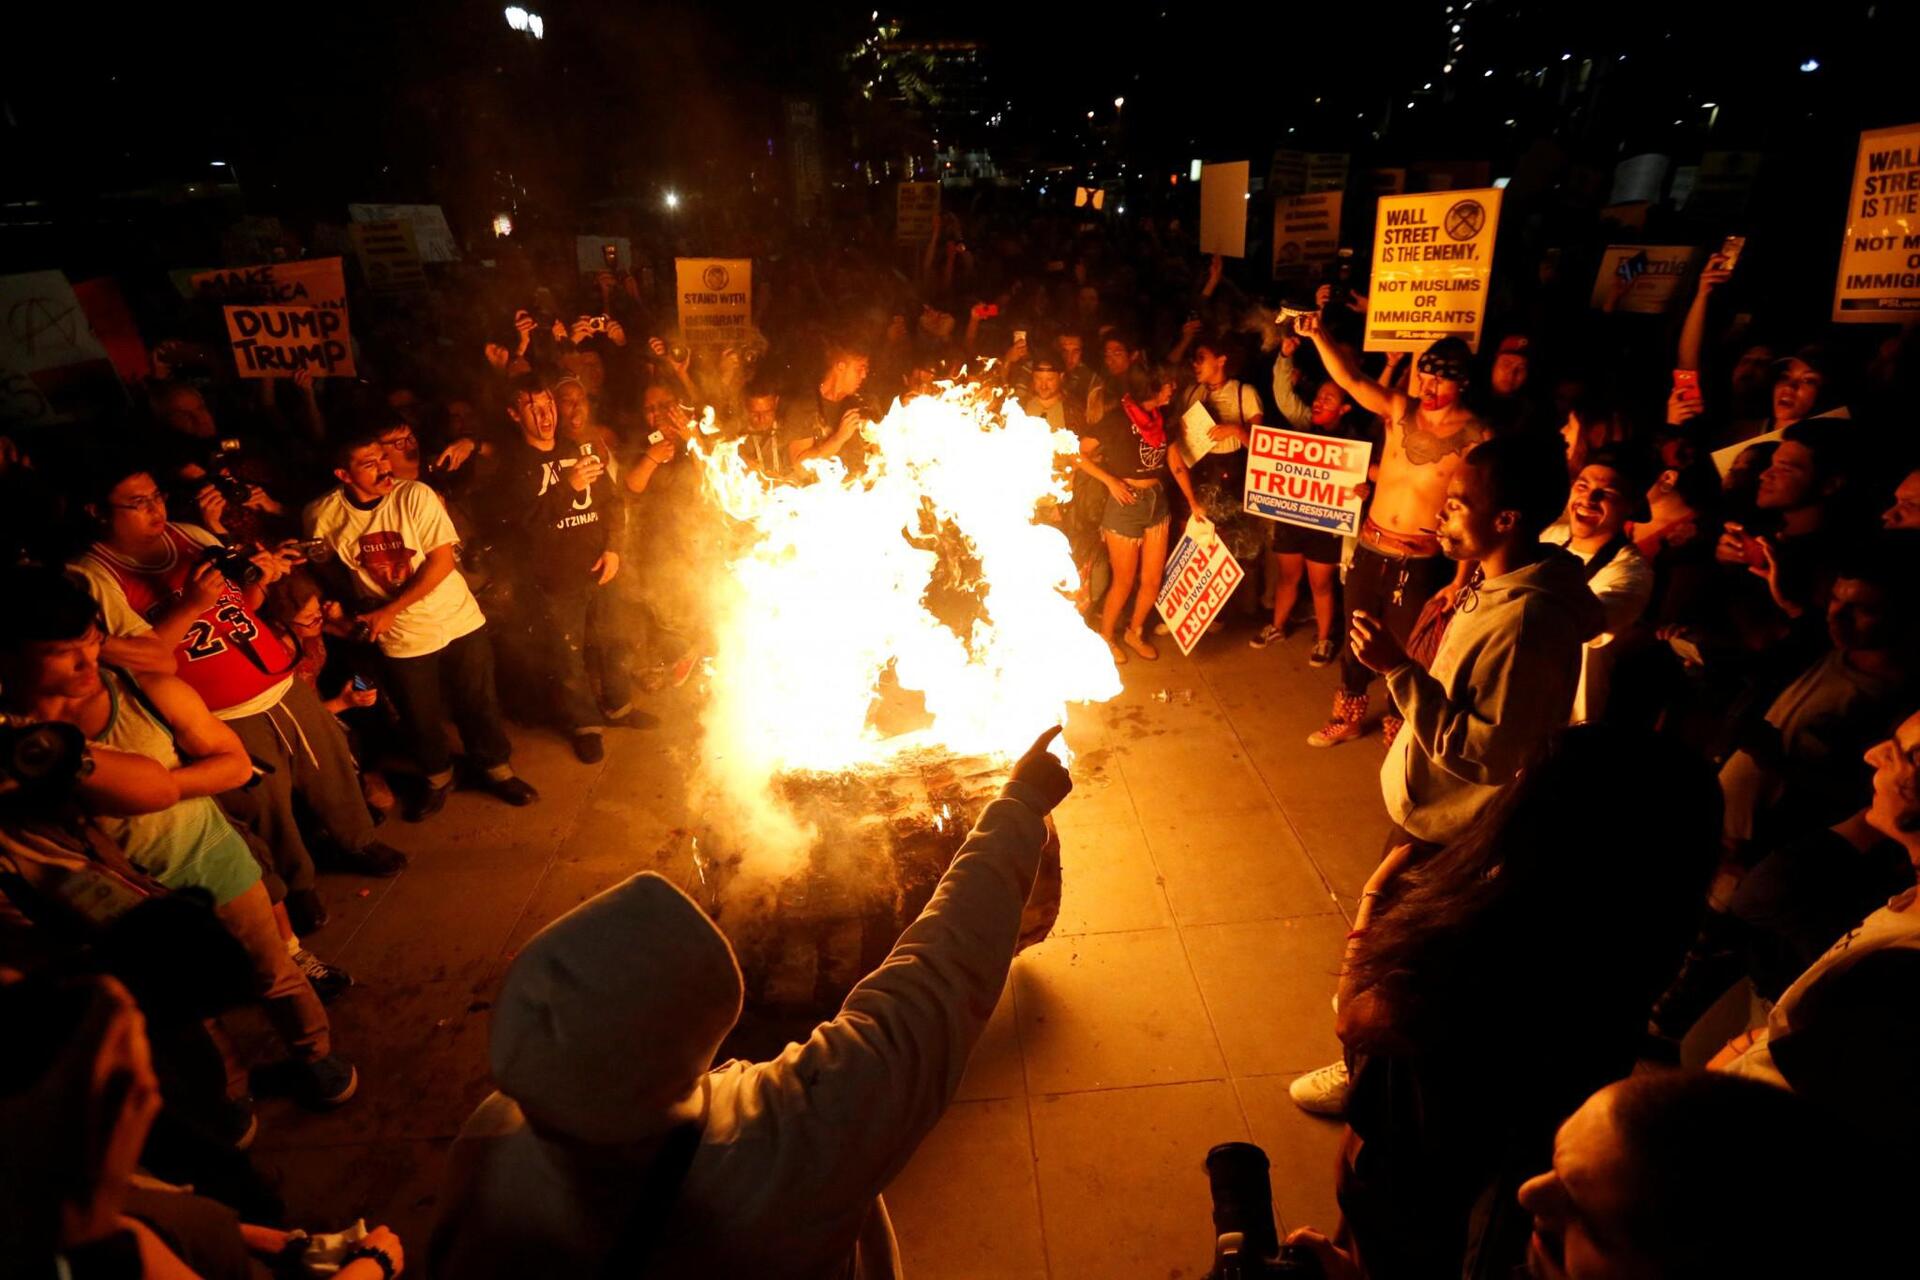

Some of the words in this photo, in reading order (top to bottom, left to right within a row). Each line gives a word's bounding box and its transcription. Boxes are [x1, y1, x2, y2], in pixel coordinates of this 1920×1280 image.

[1869, 149, 1920, 173] WAL
[1387, 208, 1427, 226] WALL
[1861, 199, 1878, 218] IS
[1883, 193, 1918, 216] THE
[1384, 226, 1440, 244] STREET
[1855, 236, 1898, 252] NOT
[1382, 247, 1394, 262] IS
[1398, 246, 1420, 261] THE
[1378, 281, 1407, 292] NOT
[1410, 279, 1480, 292] MUSLIMS
[684, 292, 718, 305] STAND
[719, 292, 746, 305] WITH
[1414, 295, 1437, 307] OR
[233, 309, 340, 340] DUMP
[1374, 310, 1476, 324] IMMIGRANTS
[233, 338, 346, 373] TRUMP
[1255, 432, 1360, 468] DEPORT
[1275, 462, 1330, 481] DONALD
[1250, 468, 1356, 507] TRUMP
[1249, 493, 1298, 512] INDIGENOUS
[1299, 503, 1354, 523] RESISTANCE
[1165, 542, 1219, 619] TRUMP
[1183, 568, 1213, 611] DONALD
[1179, 563, 1238, 646] DEPORT
[180, 604, 259, 662] 23
